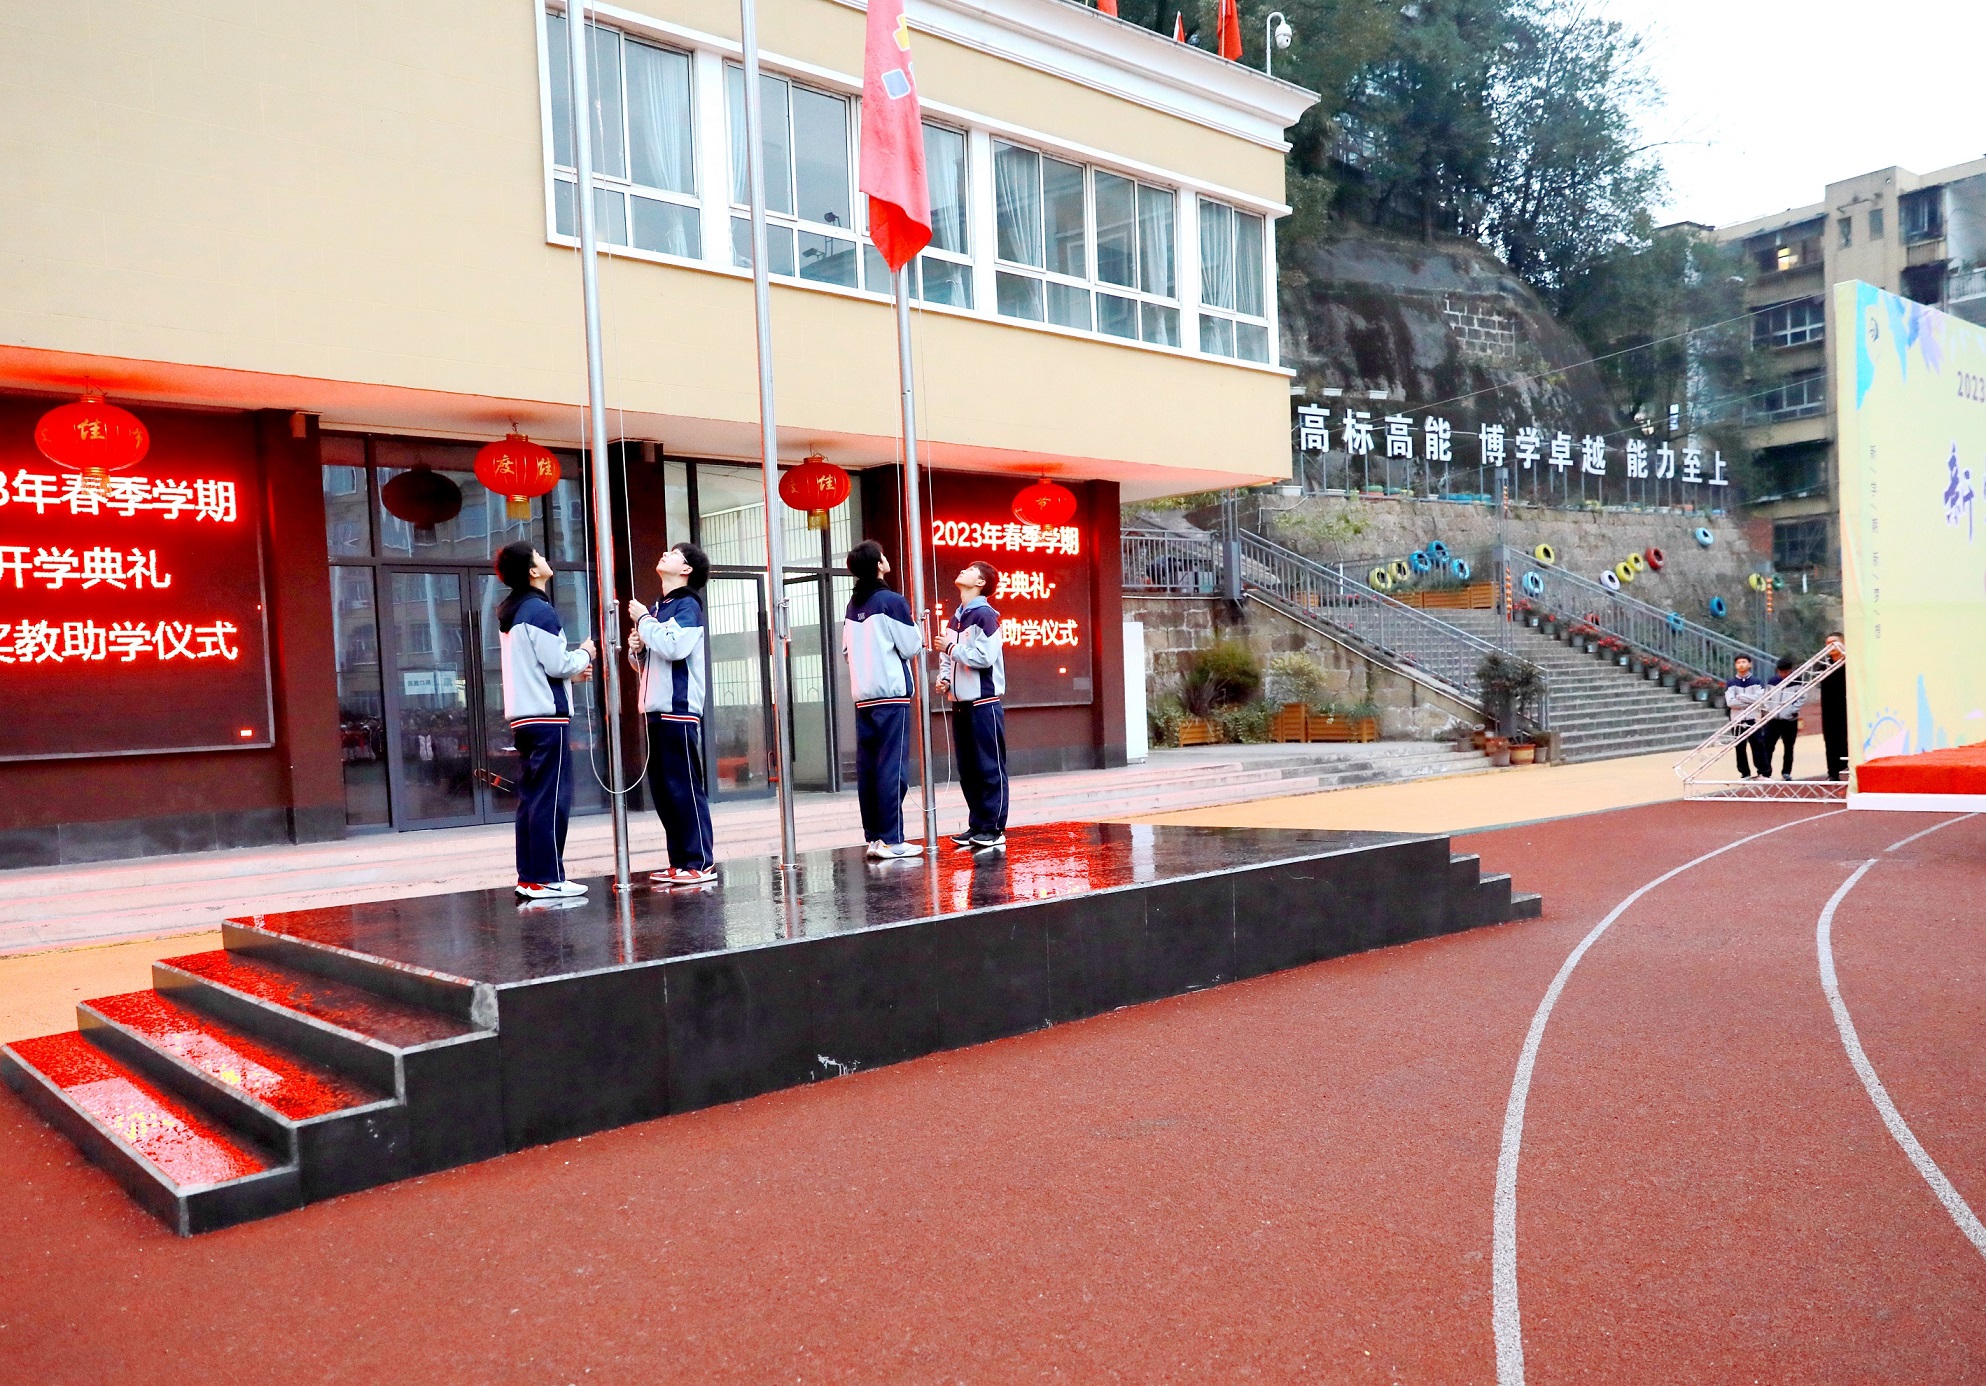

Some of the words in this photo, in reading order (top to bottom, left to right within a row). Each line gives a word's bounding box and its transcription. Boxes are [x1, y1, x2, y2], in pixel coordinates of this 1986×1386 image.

[1957, 369, 1985, 403] 2023
[1297, 403, 1453, 463] 高标高能
[1478, 422, 1607, 476] 博学卓越
[1625, 438, 1729, 486] 能力至上
[932, 519, 1080, 555] 2023年春季学期
[0, 545, 172, 590] 开学典礼
[1001, 617, 1078, 647] 助学仪式
